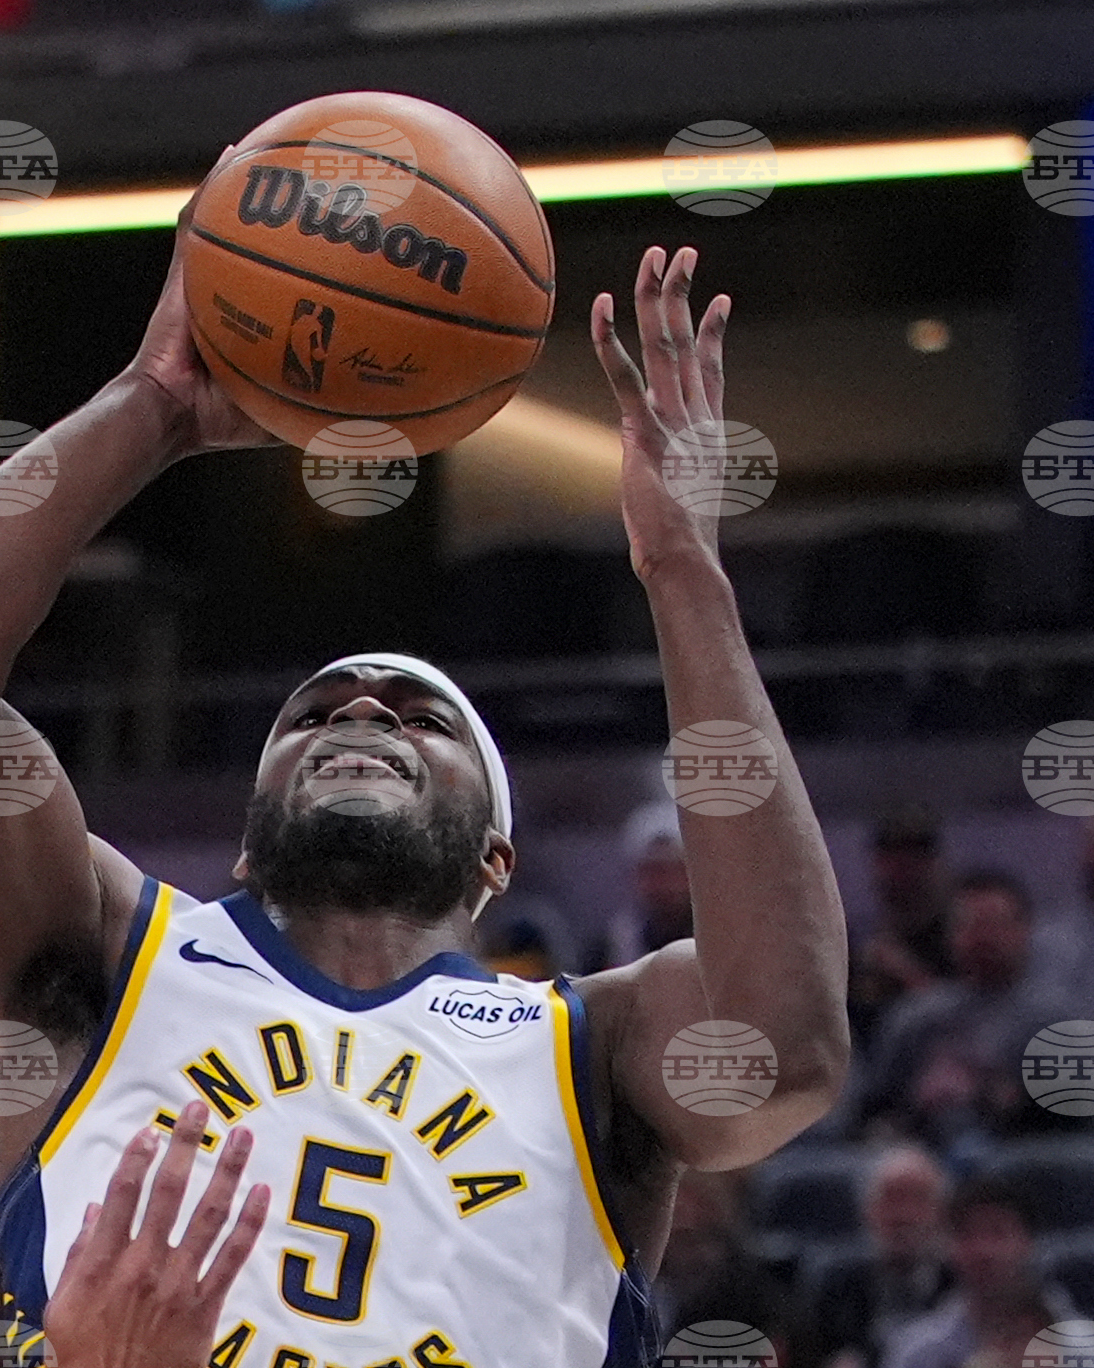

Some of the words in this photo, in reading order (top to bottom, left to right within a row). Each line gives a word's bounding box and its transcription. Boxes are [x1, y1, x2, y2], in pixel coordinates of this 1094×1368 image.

[238, 165, 467, 296] Wilson
[428, 997, 504, 1023] LUCAS
[508, 1005, 542, 1023] OIL
[277, 1135, 393, 1326] 5
